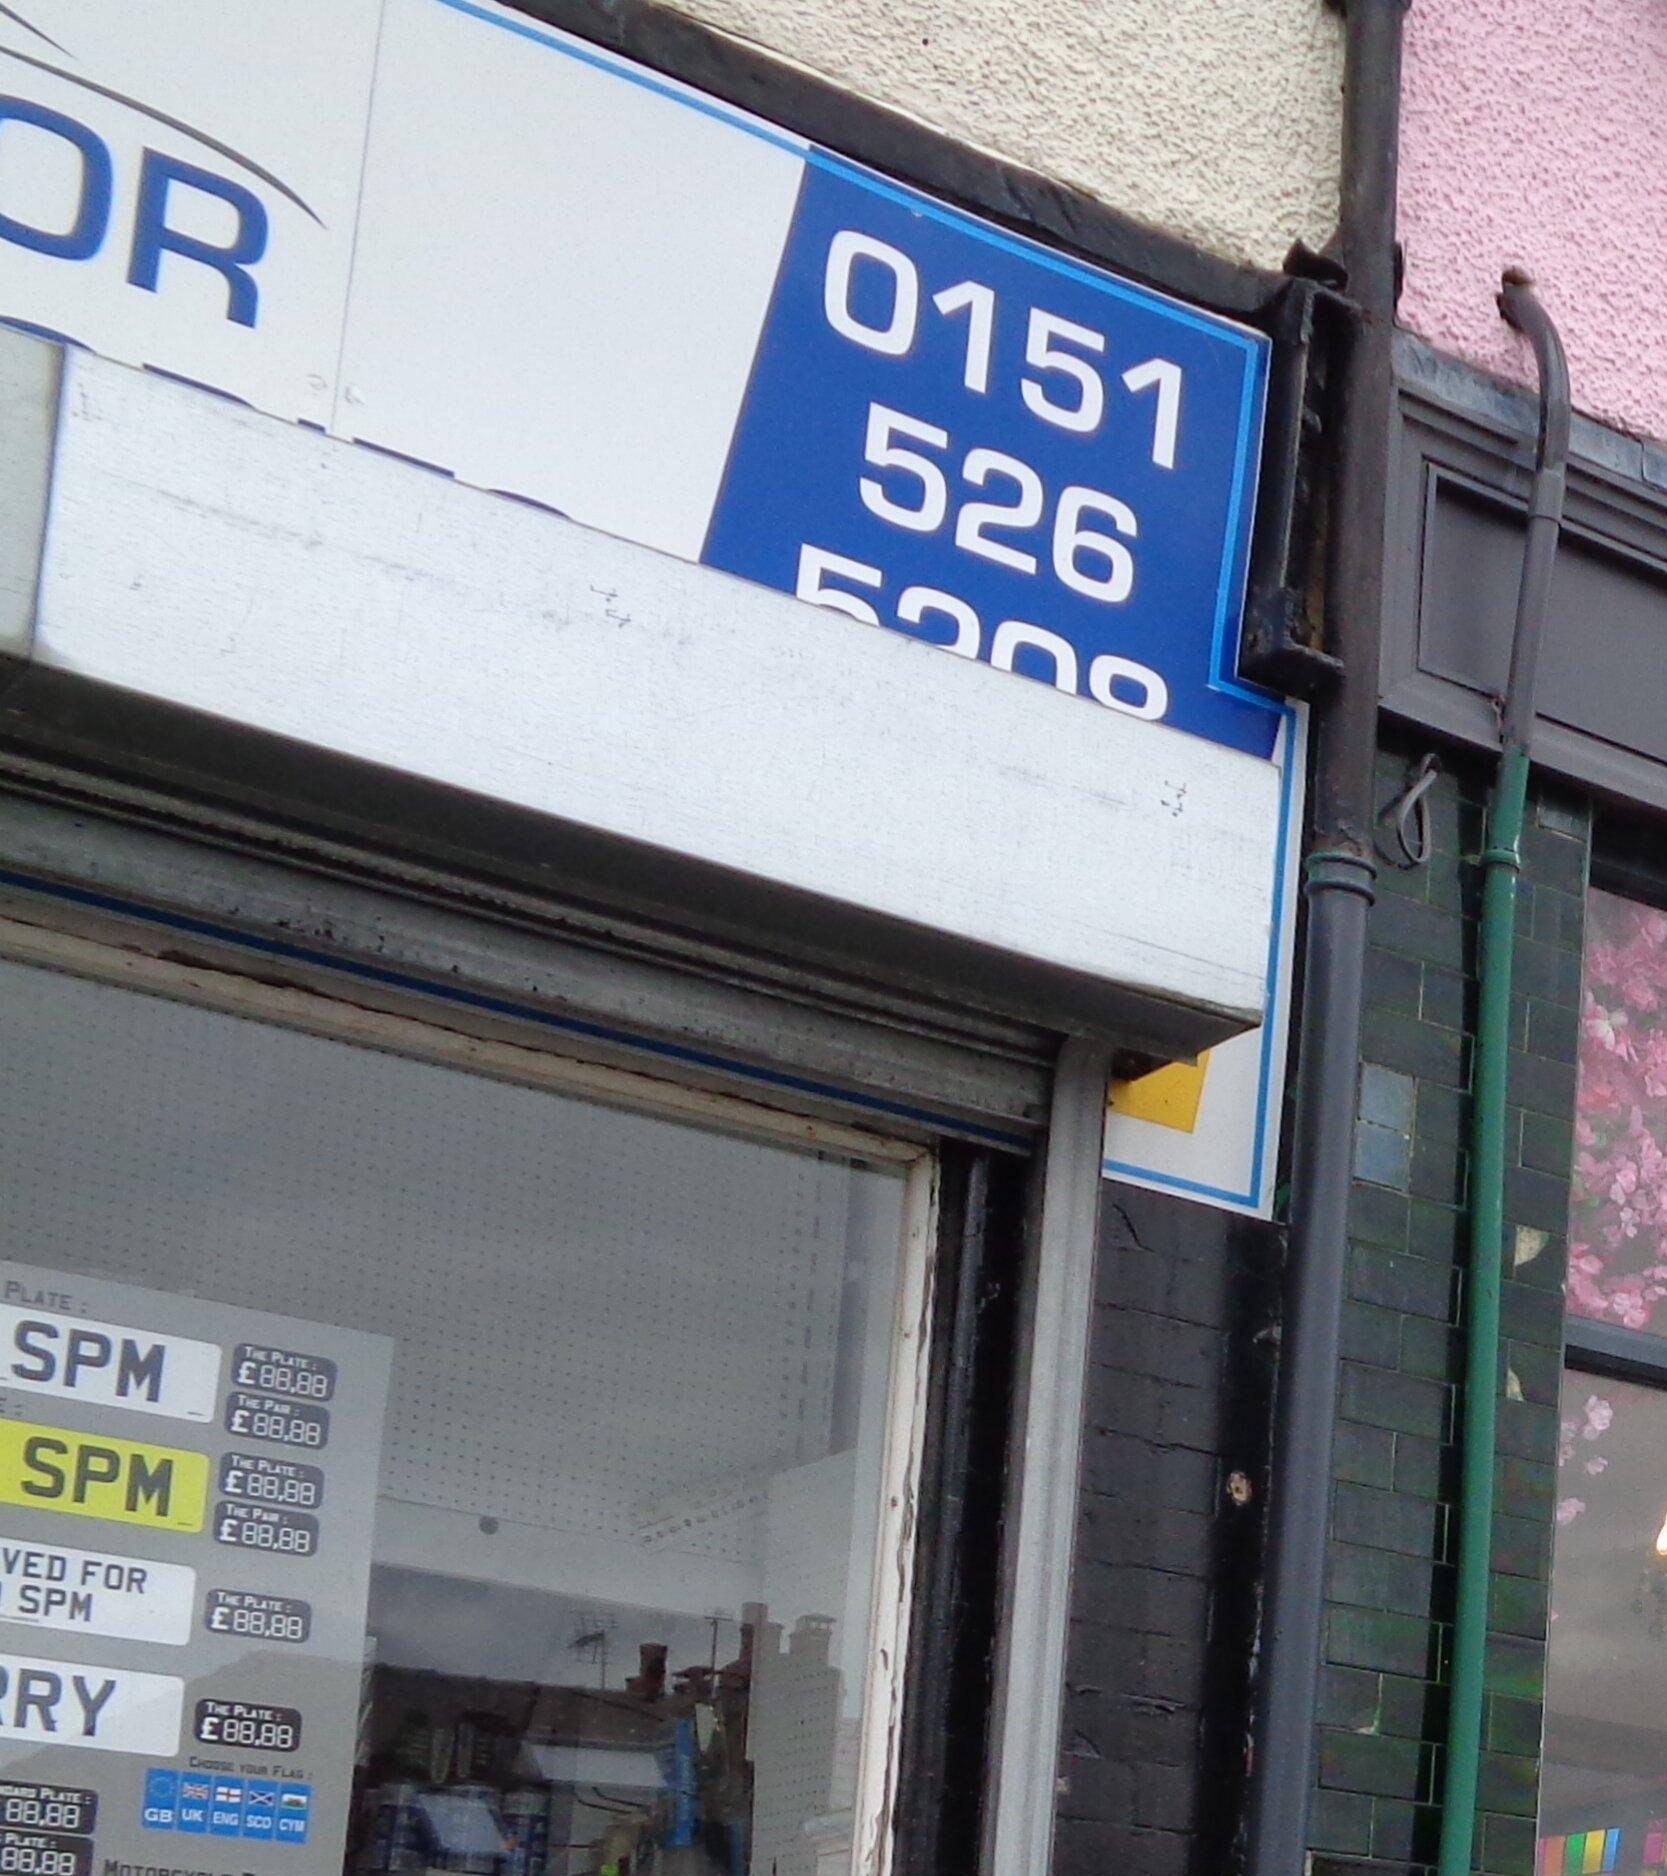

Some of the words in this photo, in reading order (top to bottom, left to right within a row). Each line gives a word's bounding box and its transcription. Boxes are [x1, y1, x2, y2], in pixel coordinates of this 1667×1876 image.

[825, 230, 1182, 470] 0151
[860, 402, 1137, 602] 526
[11, 1320, 165, 1402] SPM
[20, 1436, 173, 1517] SPM
[18, 1585, 93, 1621] SPM
[81, 1560, 147, 1594] FOR
[144, 1808, 172, 1822] GB
[182, 1809, 203, 1822] UK
[213, 1812, 238, 1825] ENG
[247, 1816, 271, 1829] SCO
